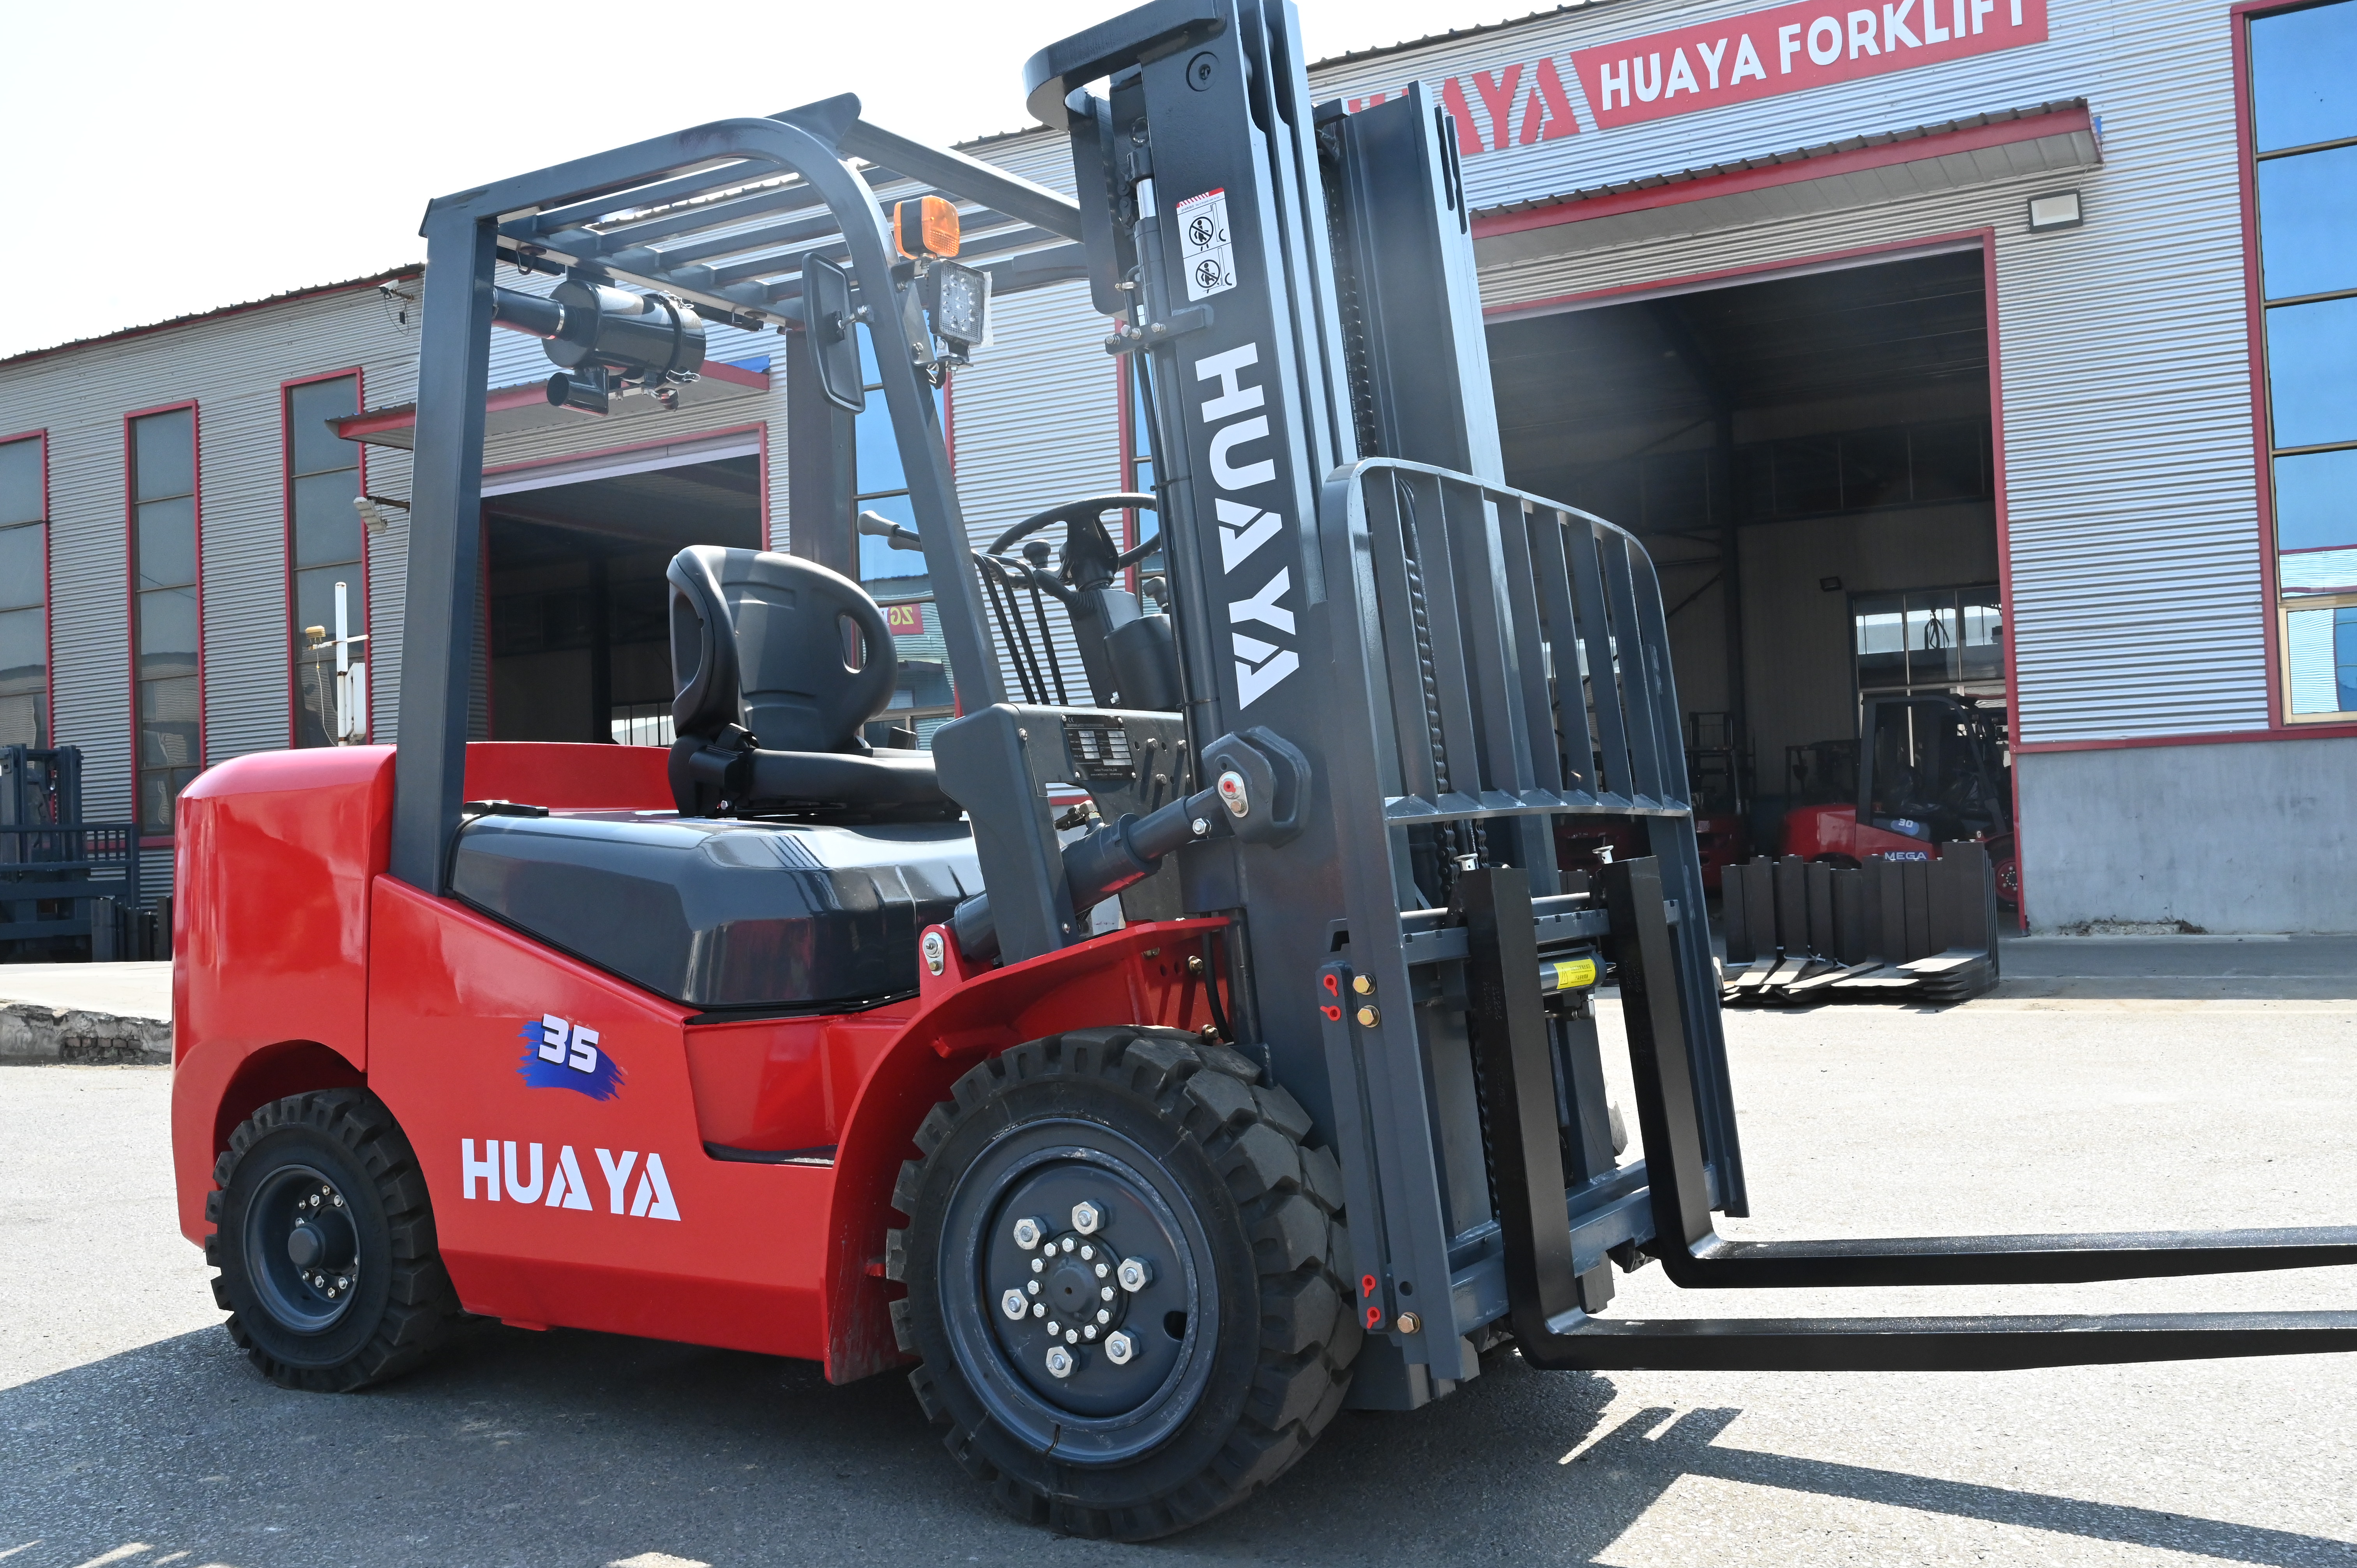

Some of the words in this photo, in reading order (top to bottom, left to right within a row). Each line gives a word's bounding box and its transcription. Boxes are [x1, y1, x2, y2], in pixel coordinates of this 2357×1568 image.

[1348, 57, 1580, 156] AYA
[1601, 34, 1767, 111] HUAYA
[1194, 342, 1300, 711] HUAYA
[1898, 818, 1913, 828] 30
[537, 1013, 599, 1074] 35
[461, 1138, 681, 1221] HUAYA
